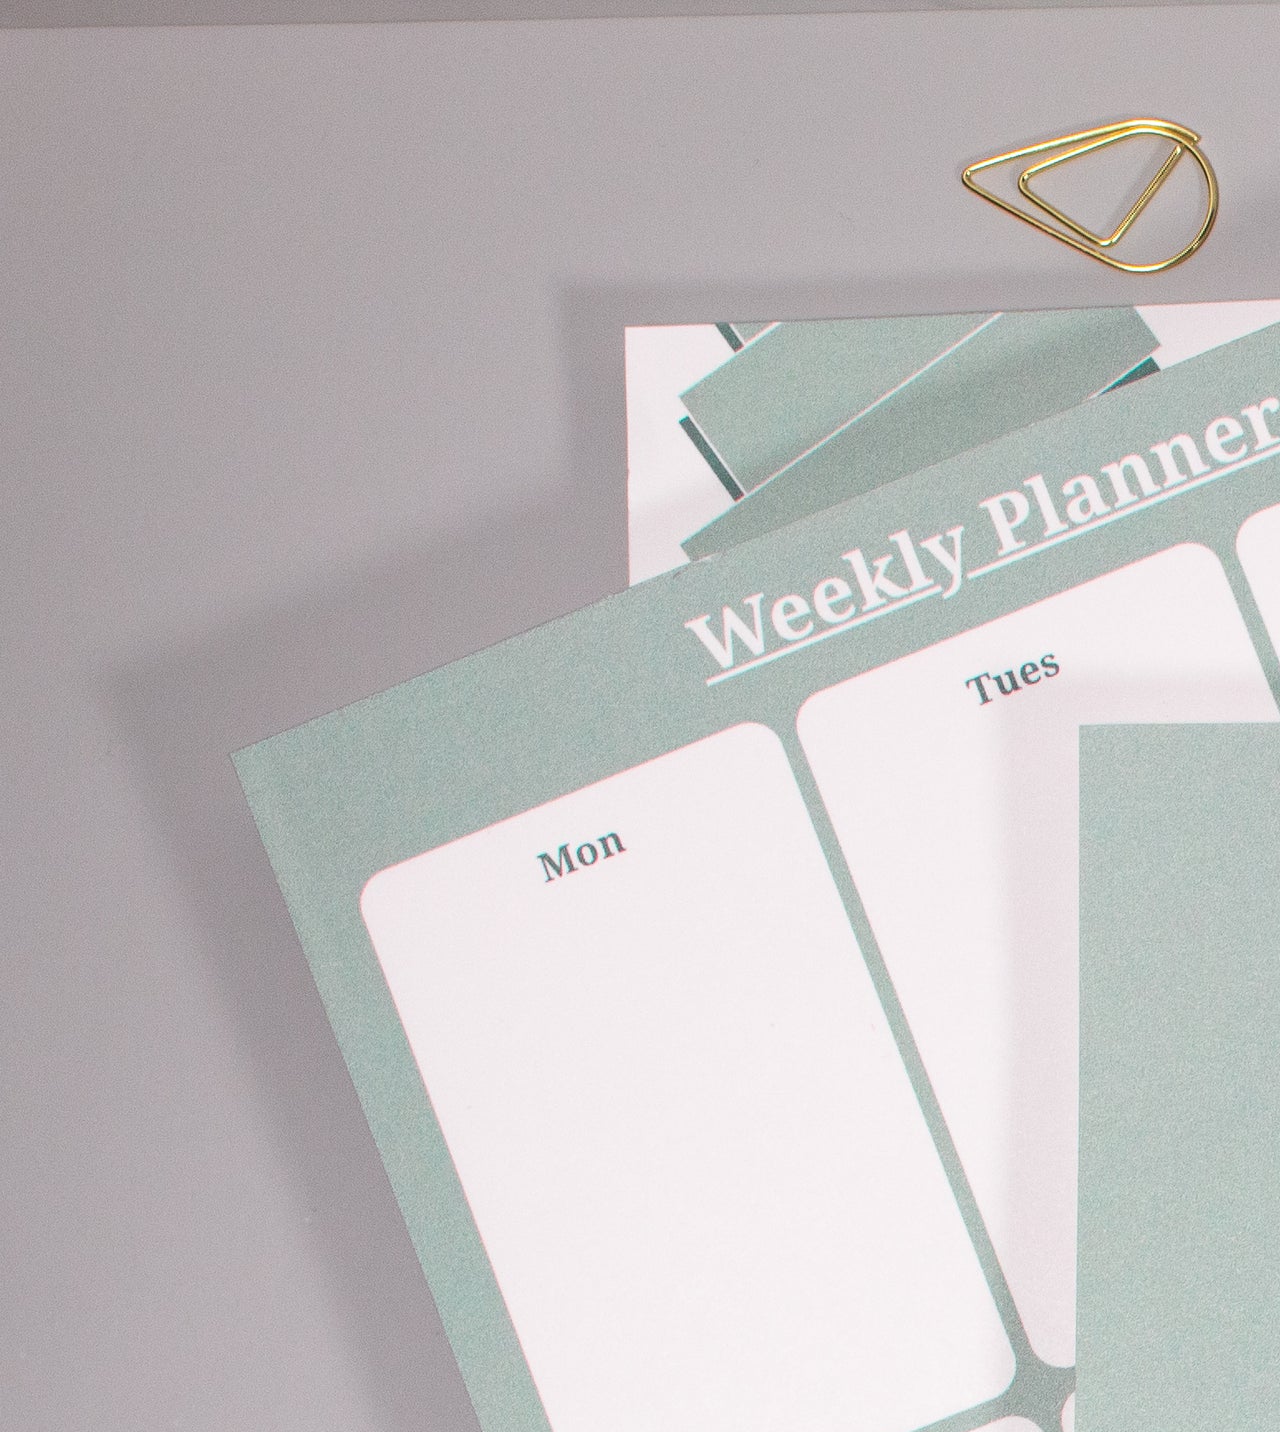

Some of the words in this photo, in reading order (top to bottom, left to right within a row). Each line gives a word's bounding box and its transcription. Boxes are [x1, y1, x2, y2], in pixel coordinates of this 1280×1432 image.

[686, 524, 966, 672] Weekly
[965, 650, 1061, 707] Tues
[537, 827, 626, 884] Mon
